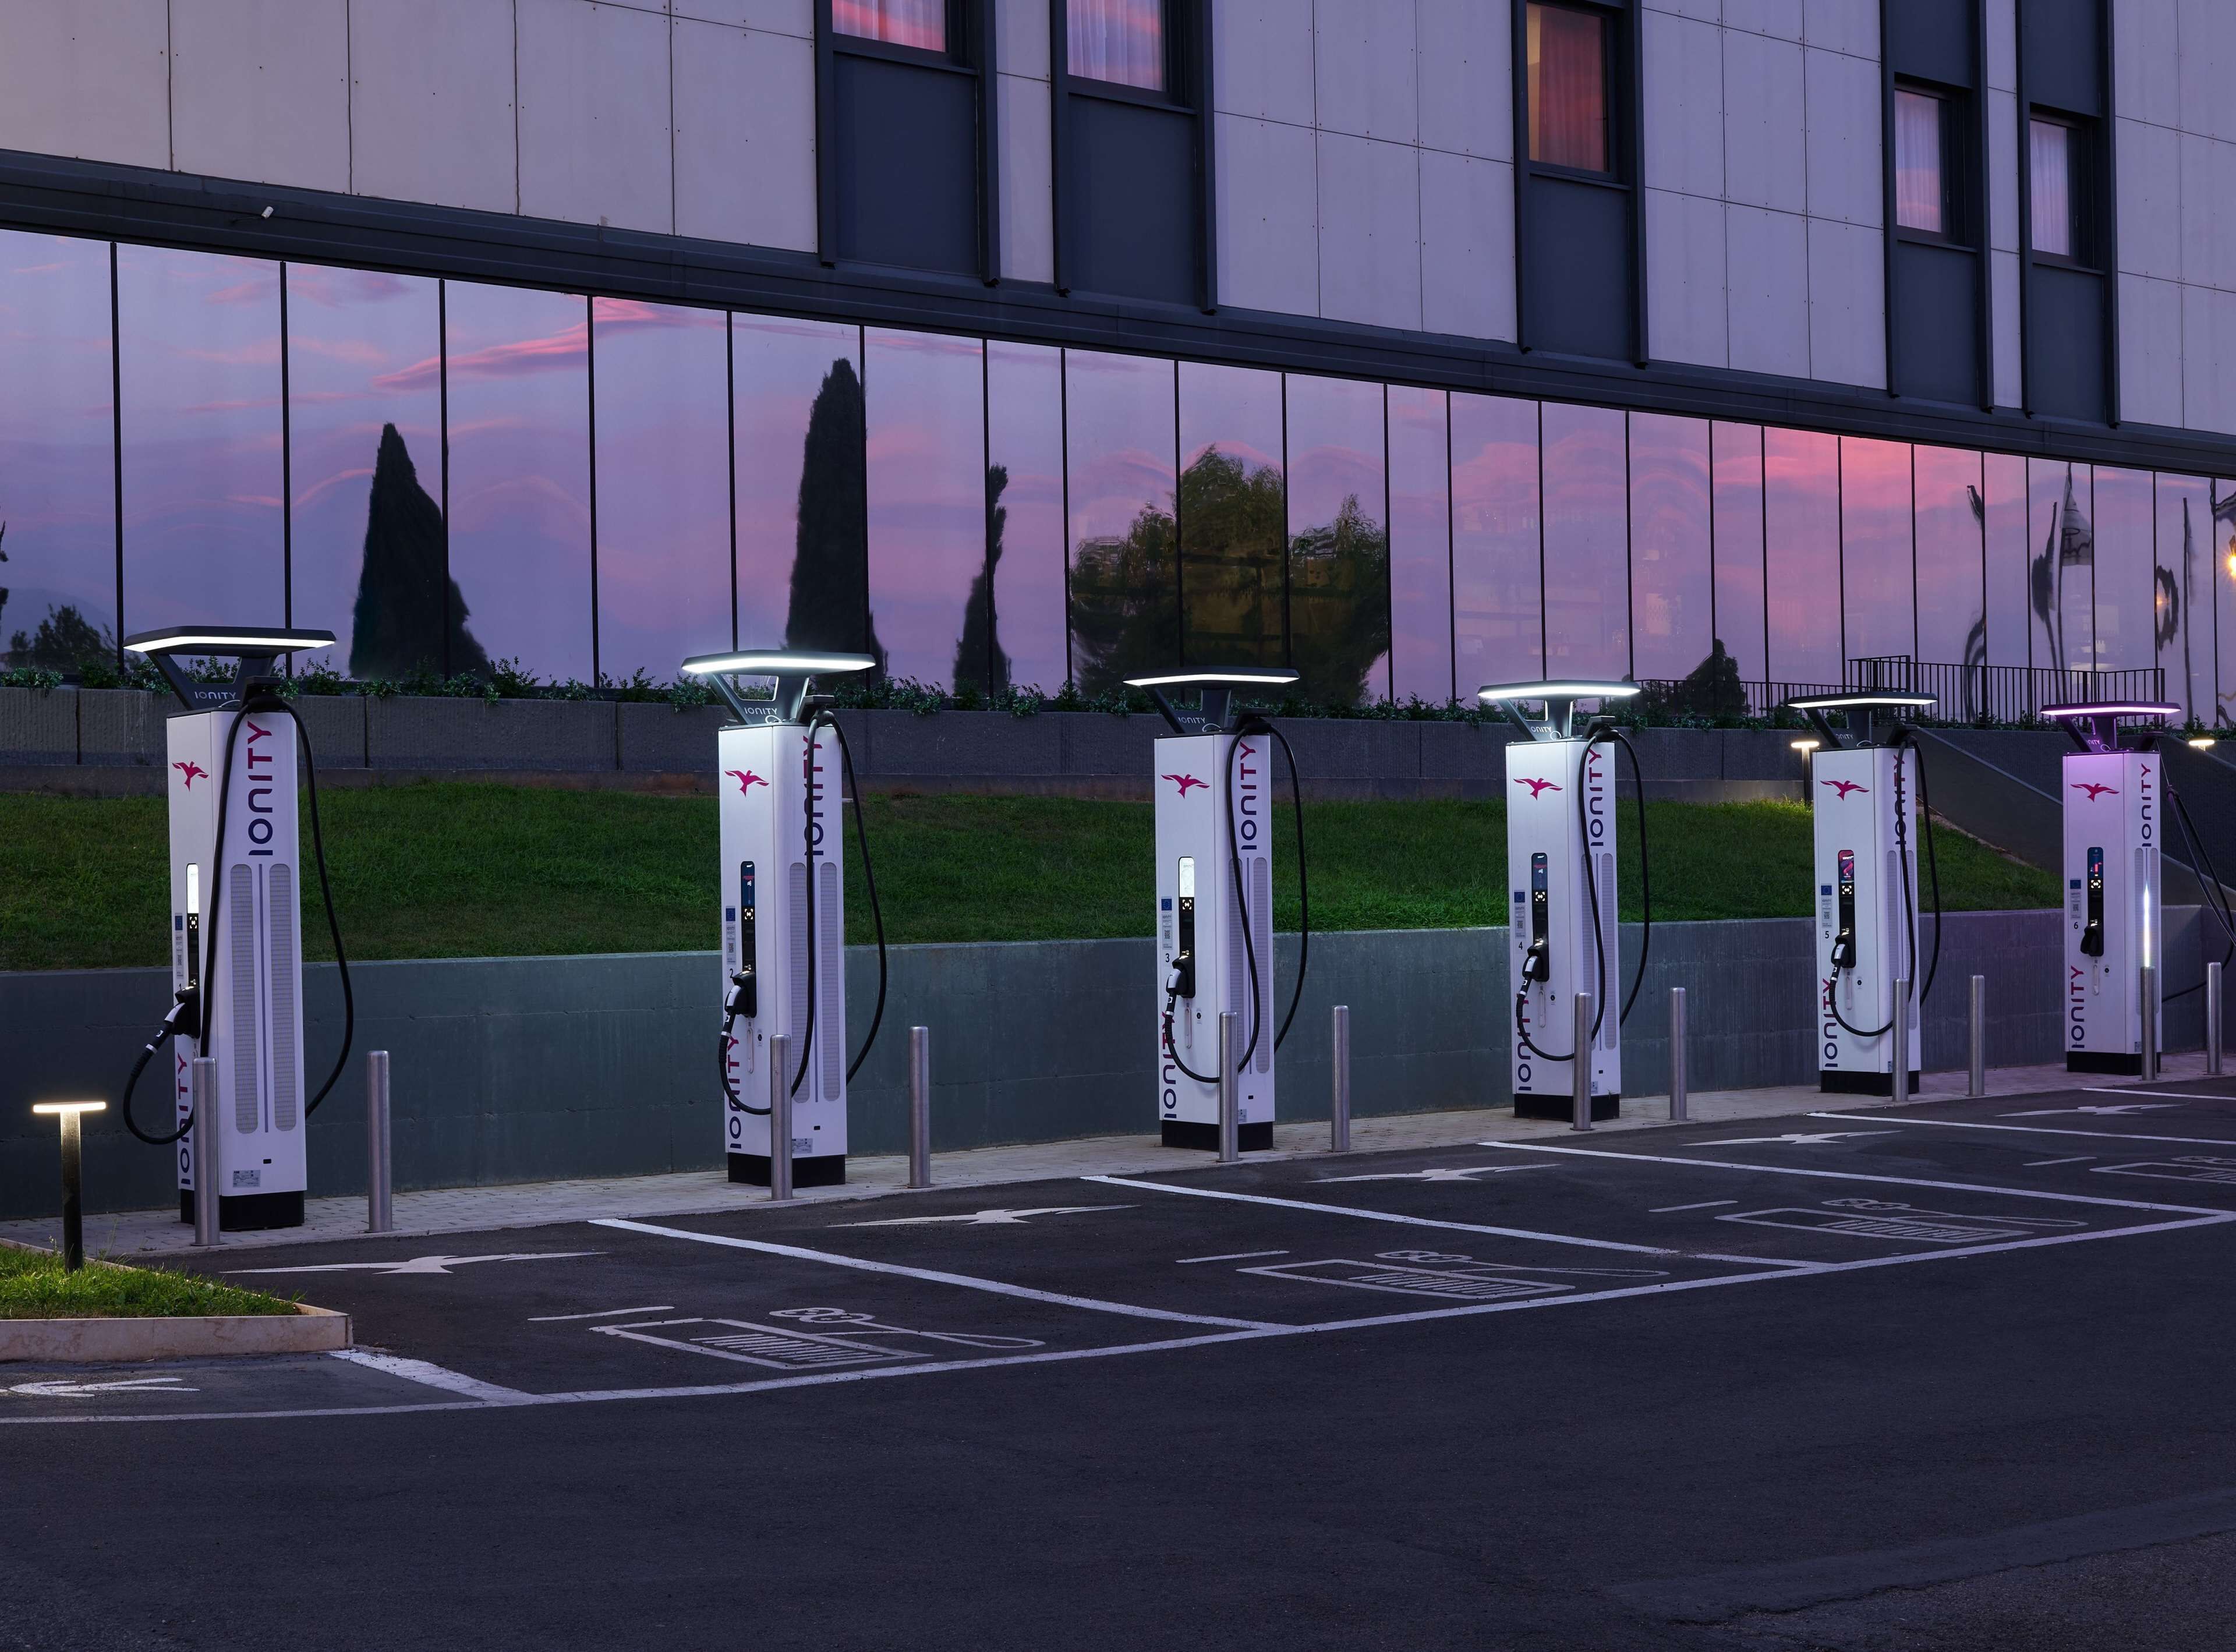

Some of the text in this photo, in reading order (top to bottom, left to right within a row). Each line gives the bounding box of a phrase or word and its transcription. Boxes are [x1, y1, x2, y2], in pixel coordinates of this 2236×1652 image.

[194, 691, 236, 700] IONITY
[744, 707, 778, 715] IONITY
[247, 721, 273, 856] IONITY
[1240, 742, 1257, 850] IONITY
[1588, 748, 1604, 847] IONITY
[2141, 763, 2152, 847] IONITY
[1165, 953, 1170, 963] 3
[1519, 942, 1523, 950] 4
[1825, 931, 1829, 939] 5
[730, 968, 734, 978] 2
[2071, 965, 2085, 1049] IONITY
[1517, 993, 1531, 1091] IONI
